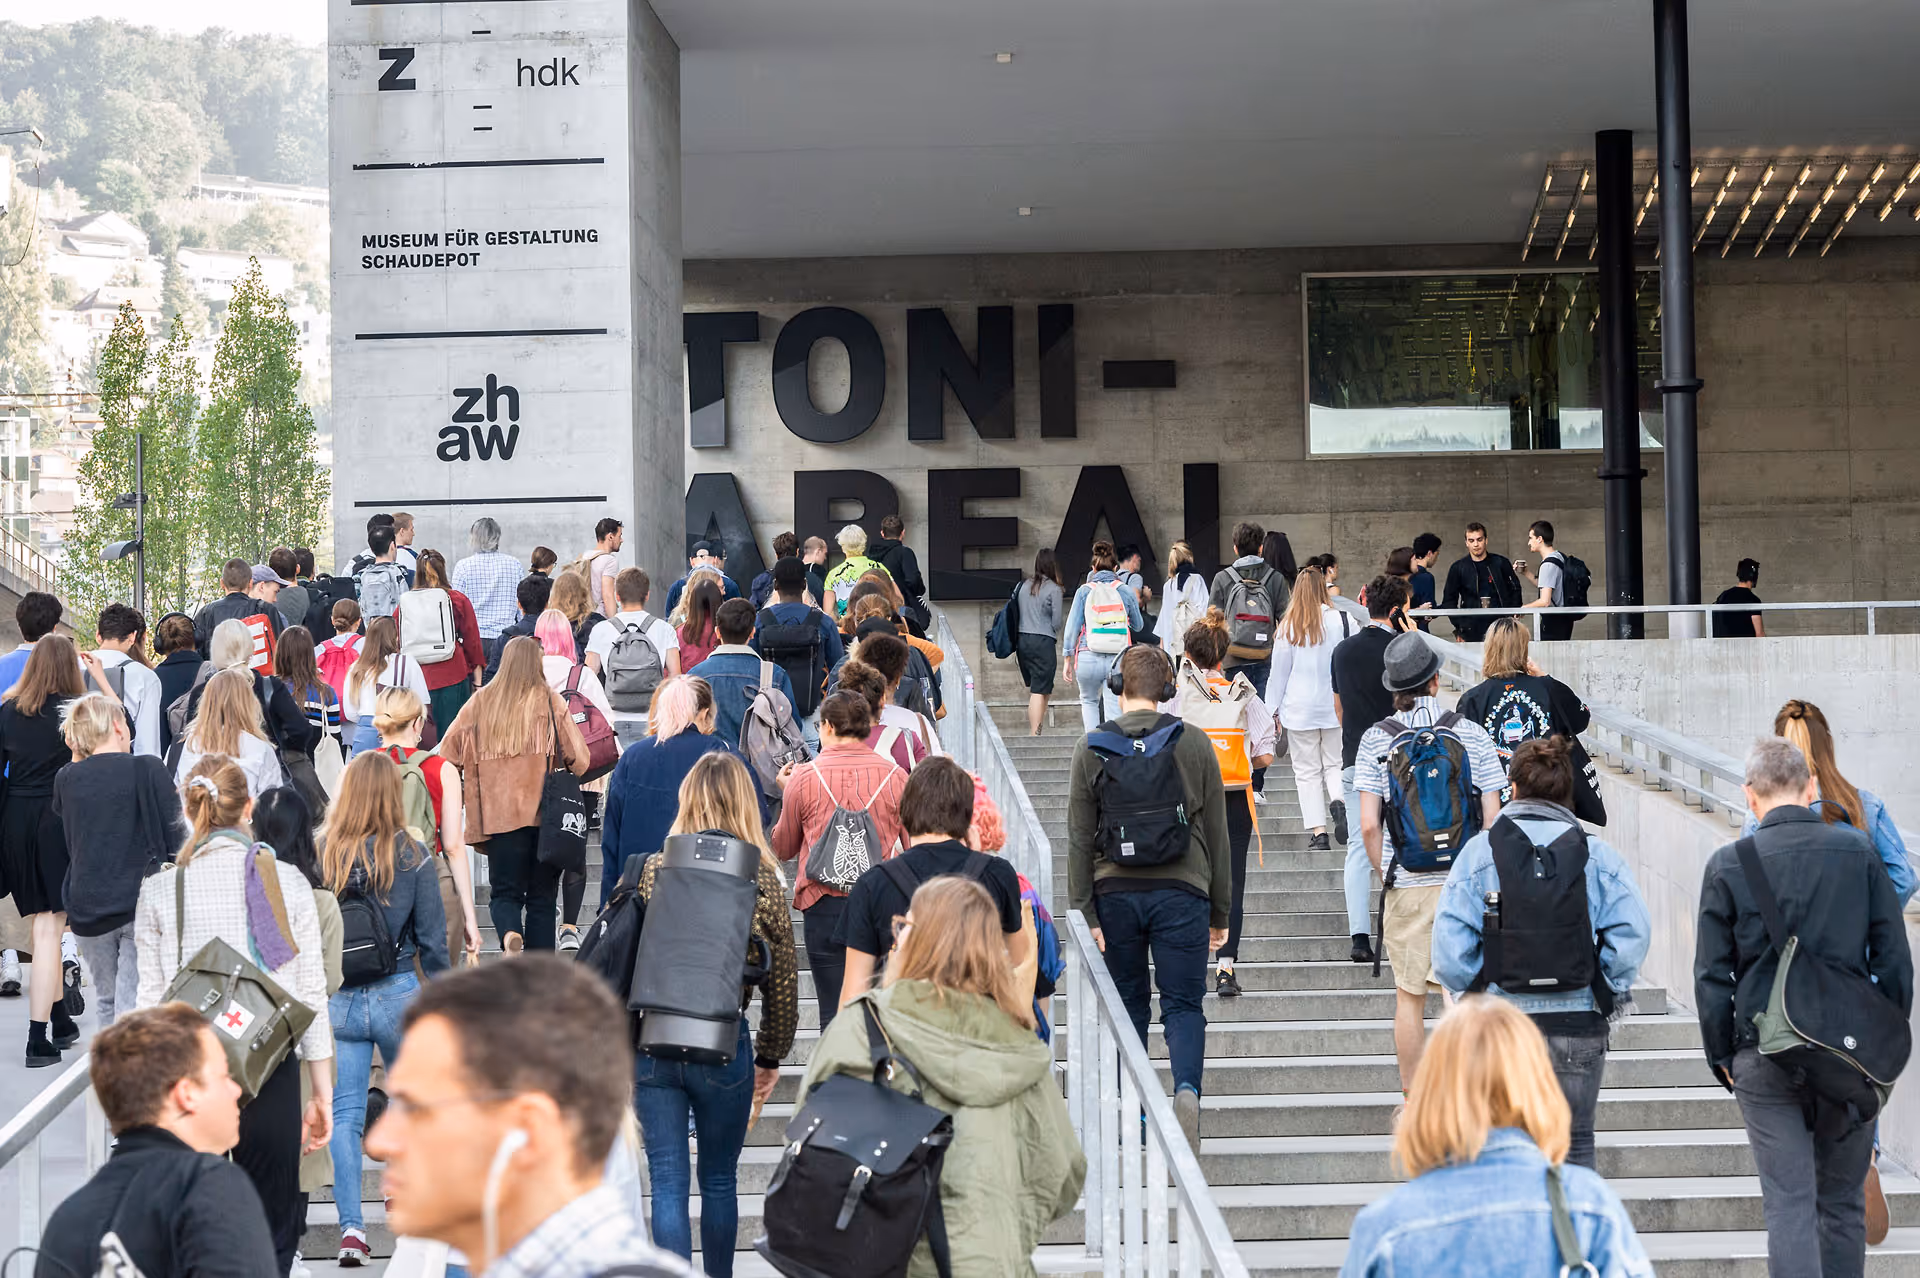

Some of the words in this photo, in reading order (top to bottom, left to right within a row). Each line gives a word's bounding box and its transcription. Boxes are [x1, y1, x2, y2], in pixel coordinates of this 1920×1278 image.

[517, 57, 580, 87] hdk
[361, 233, 439, 249] MUSEUM
[444, 229, 480, 247] FÜR
[484, 229, 599, 246] GESTALTUNG
[361, 252, 481, 270] SCHAUDEPOT
[451, 373, 520, 423] zh
[436, 424, 520, 462] aw
